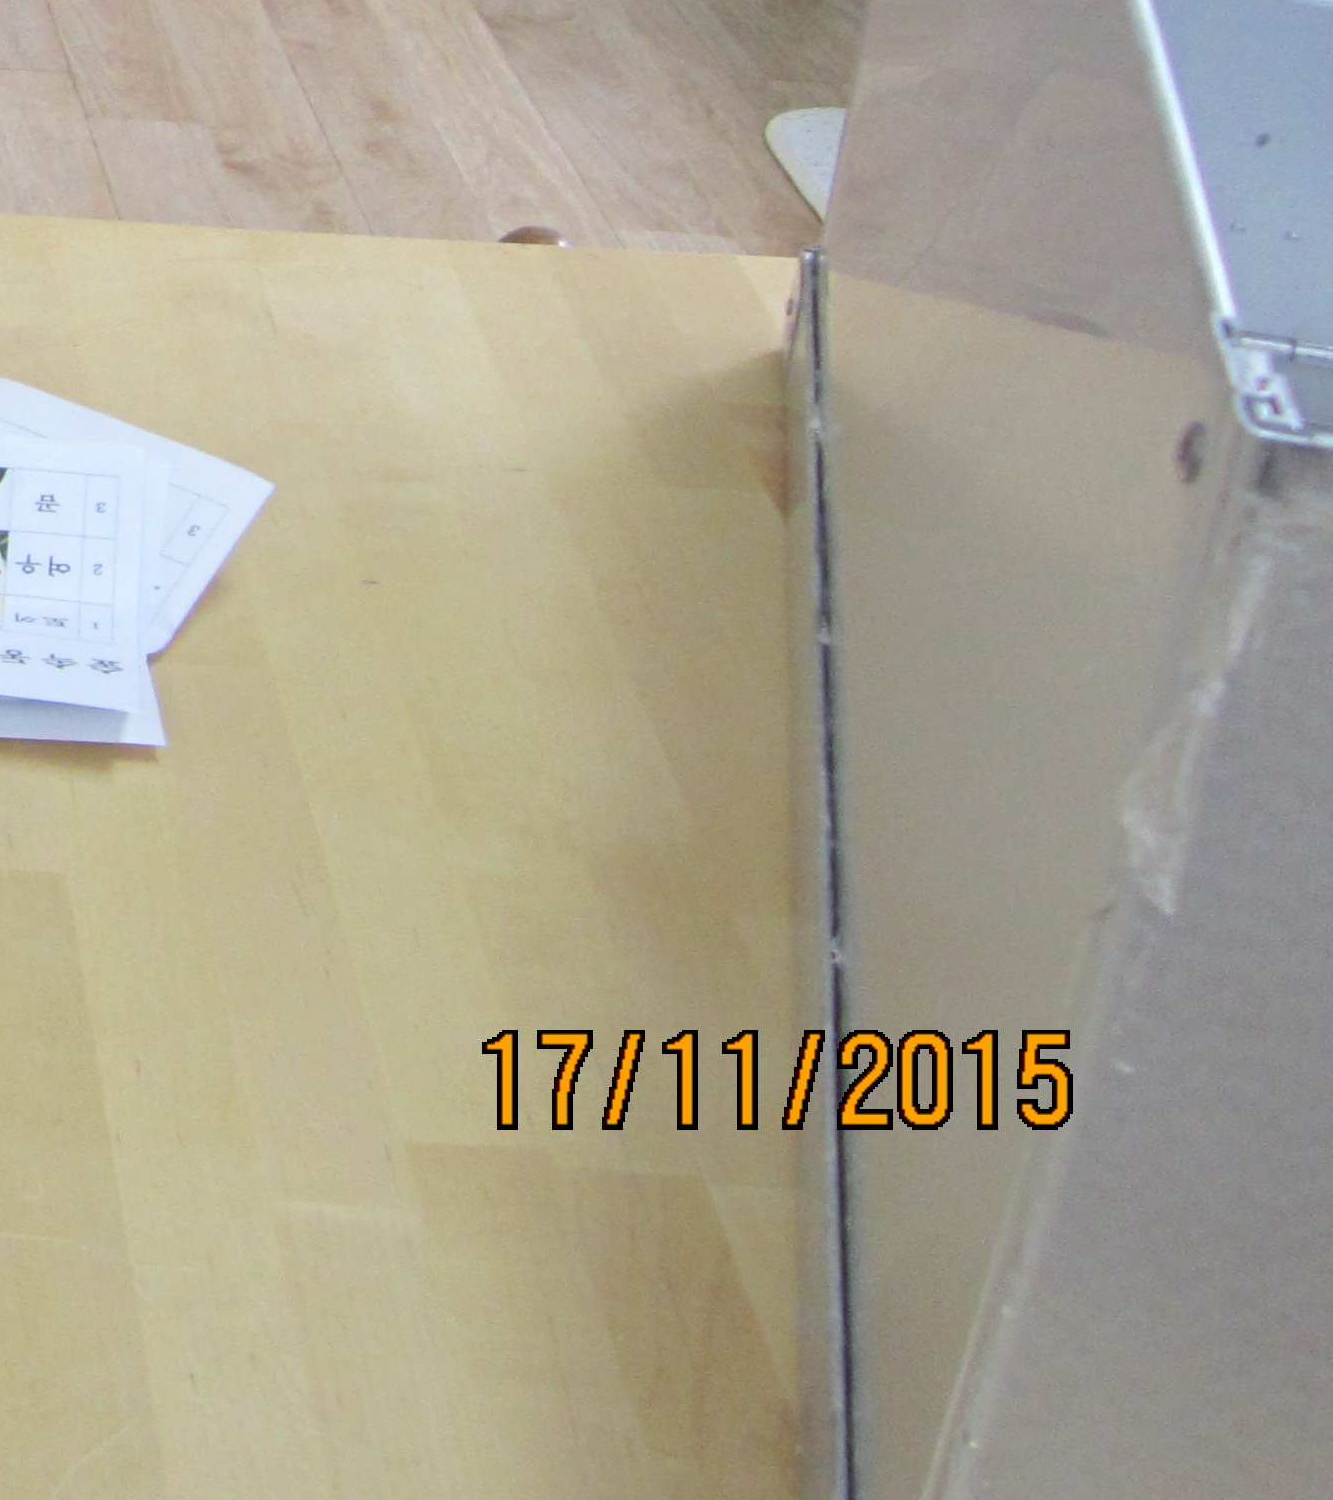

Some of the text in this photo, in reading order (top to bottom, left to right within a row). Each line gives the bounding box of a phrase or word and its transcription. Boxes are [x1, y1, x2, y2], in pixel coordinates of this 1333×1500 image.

[34, 494, 106, 513] 3 곰
[188, 525, 201, 536] 3
[15, 554, 103, 577] 2 여우
